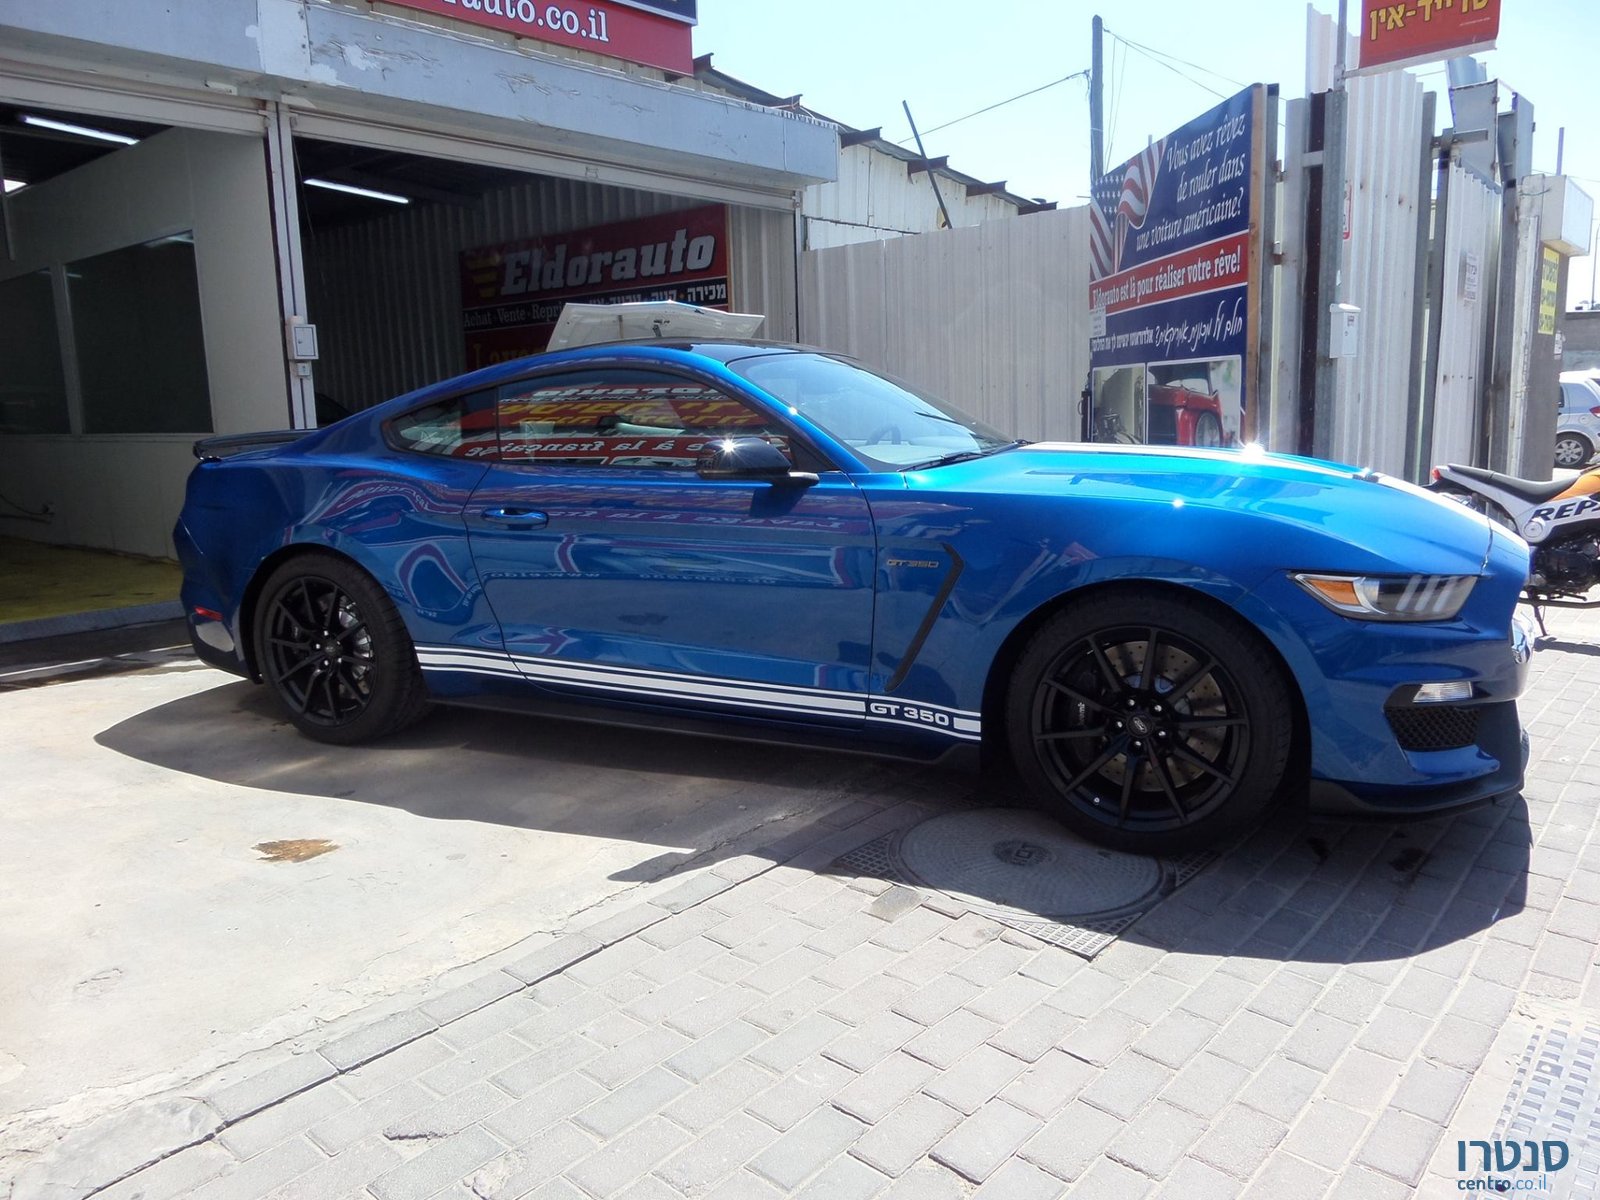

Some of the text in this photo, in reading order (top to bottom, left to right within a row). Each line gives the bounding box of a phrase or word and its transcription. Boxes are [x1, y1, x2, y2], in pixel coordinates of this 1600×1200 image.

[443, 0, 609, 42] auto.co.il
[1167, 113, 1246, 172] Vous avez rêvez
[1176, 149, 1246, 203] de rouler dans
[1136, 186, 1244, 252] une voiture américaine?
[500, 228, 716, 296] Eldorauto
[1120, 282, 1129, 301] est
[1130, 276, 1137, 298] là
[1137, 277, 1155, 304] pour
[1155, 264, 1186, 292] réaliser
[1187, 257, 1212, 282] votre
[1213, 244, 1241, 277] rêve!
[464, 301, 564, 328] Achat Vente Repri
[687, 283, 727, 302] מכירה
[870, 702, 949, 726] GT 350
